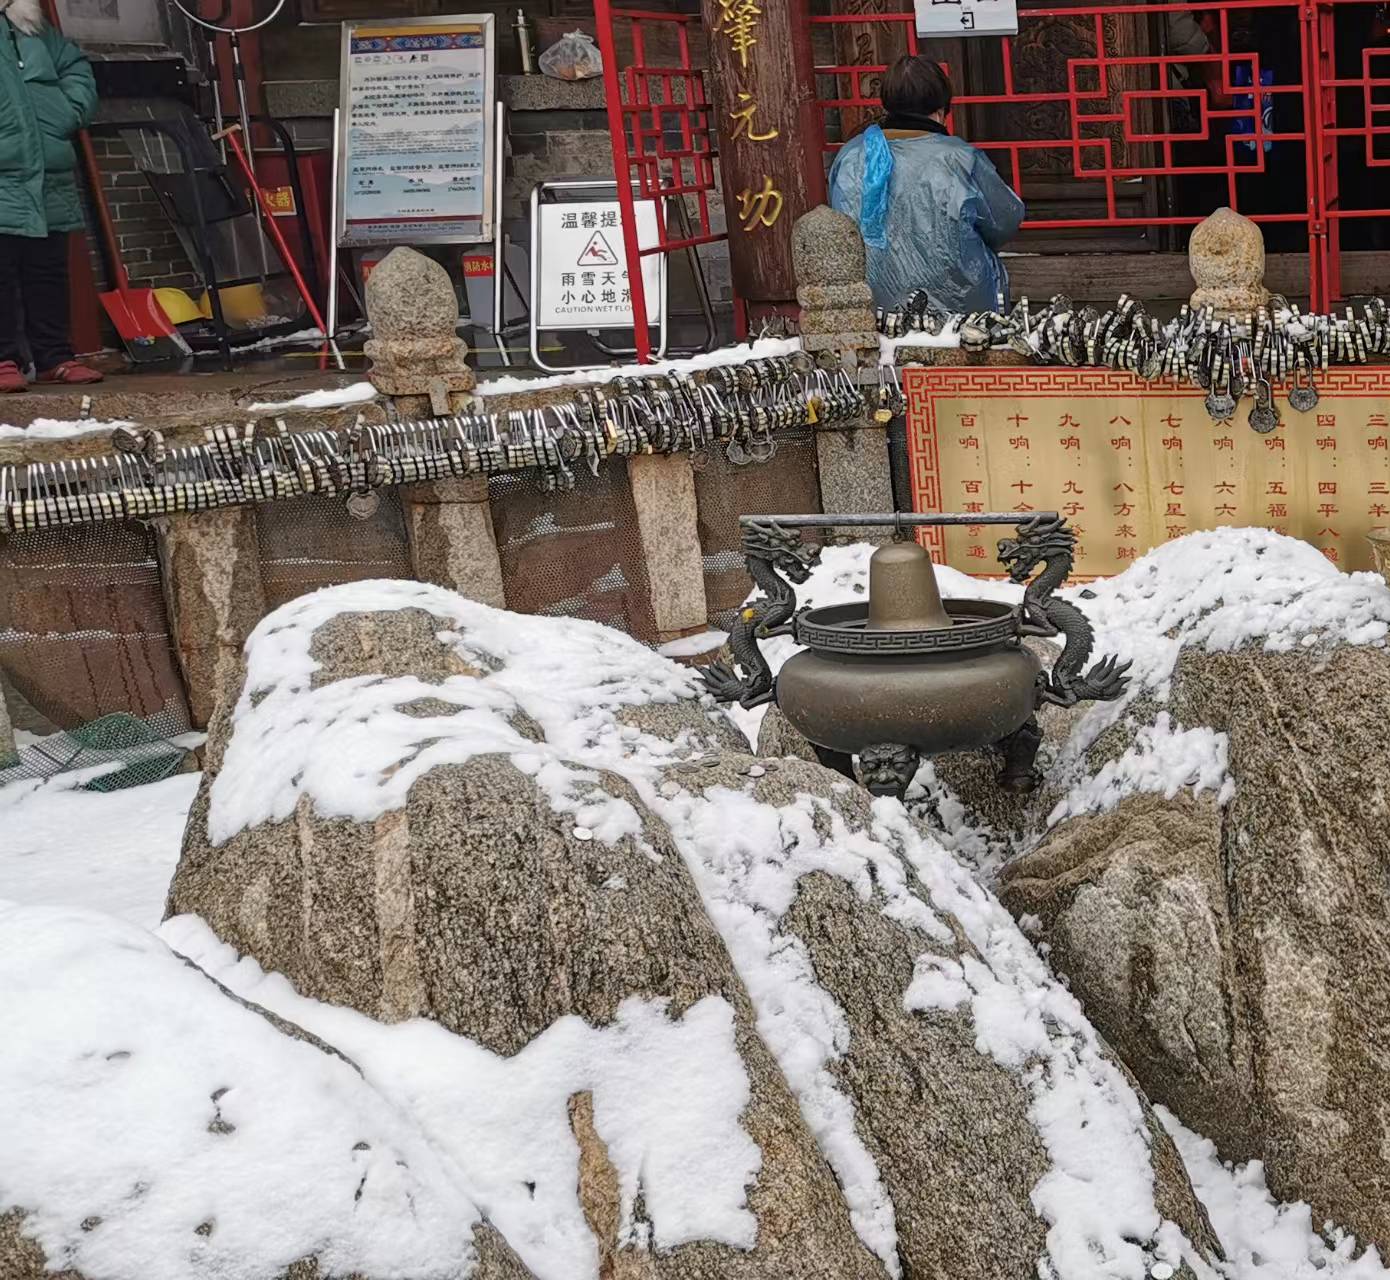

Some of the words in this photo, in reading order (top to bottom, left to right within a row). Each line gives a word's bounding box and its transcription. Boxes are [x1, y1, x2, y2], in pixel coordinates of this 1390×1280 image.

[561, 211, 623, 229] 温馨提
[555, 306, 593, 314] CAUTION
[595, 305, 613, 313] WET
